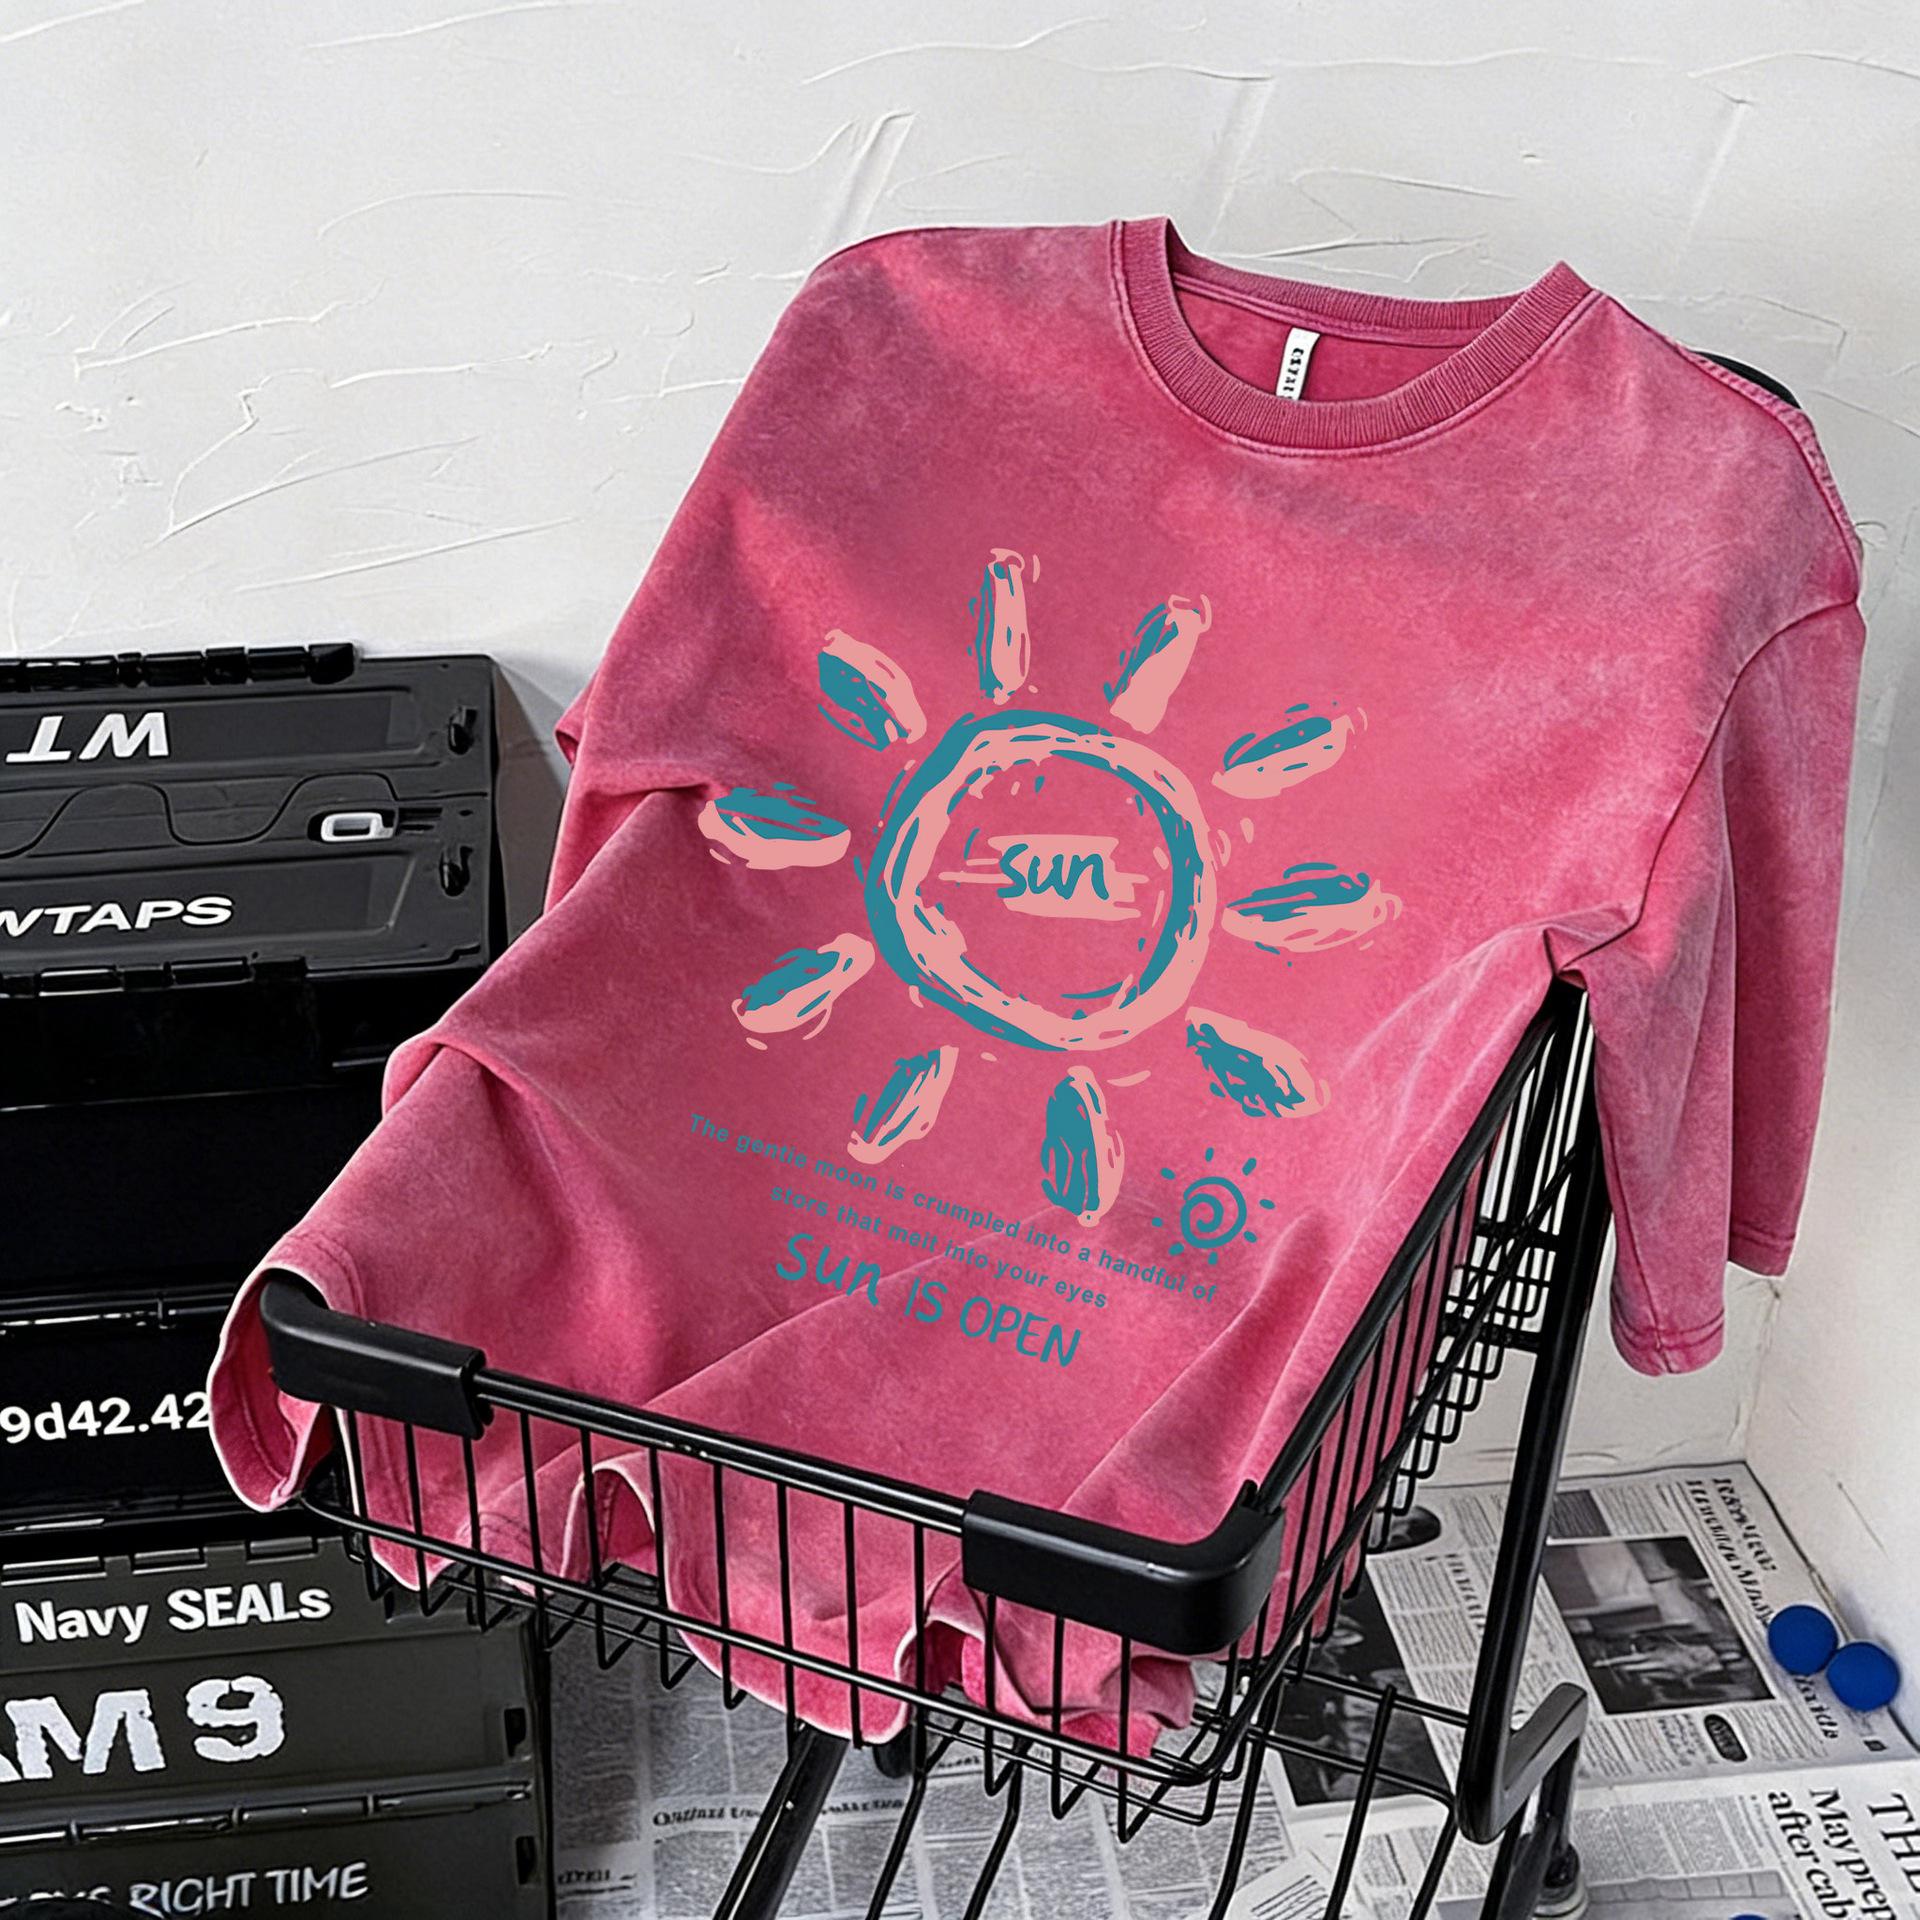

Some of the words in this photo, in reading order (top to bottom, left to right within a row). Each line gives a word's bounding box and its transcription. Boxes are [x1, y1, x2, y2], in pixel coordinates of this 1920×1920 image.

[690, 1113, 729, 1143] The
[814, 1159, 877, 1192] moon
[885, 1175, 906, 1200] is
[912, 1190, 1020, 1238] crumpled
[1026, 1224, 1071, 1255] into
[1078, 1246, 1091, 1262] a
[1099, 1249, 1186, 1293] handful
[1192, 1284, 1217, 1303] of
[836, 1204, 882, 1234] that
[944, 1239, 989, 1269] into
[994, 1259, 1048, 1289] your
[1055, 1280, 1107, 1309] eyes
[904, 1276, 948, 1323] IS
[959, 1296, 1081, 1367] OPEN
[15, 1600, 149, 1643] Navy
[167, 1582, 333, 1630] SEALs
[186, 1676, 285, 1762] 9
[1768, 1791, 1820, 1863] after
[1809, 1788, 1860, 1853] May
[129, 1871, 257, 1919] RIGHT
[265, 1862, 369, 1904] TIME
